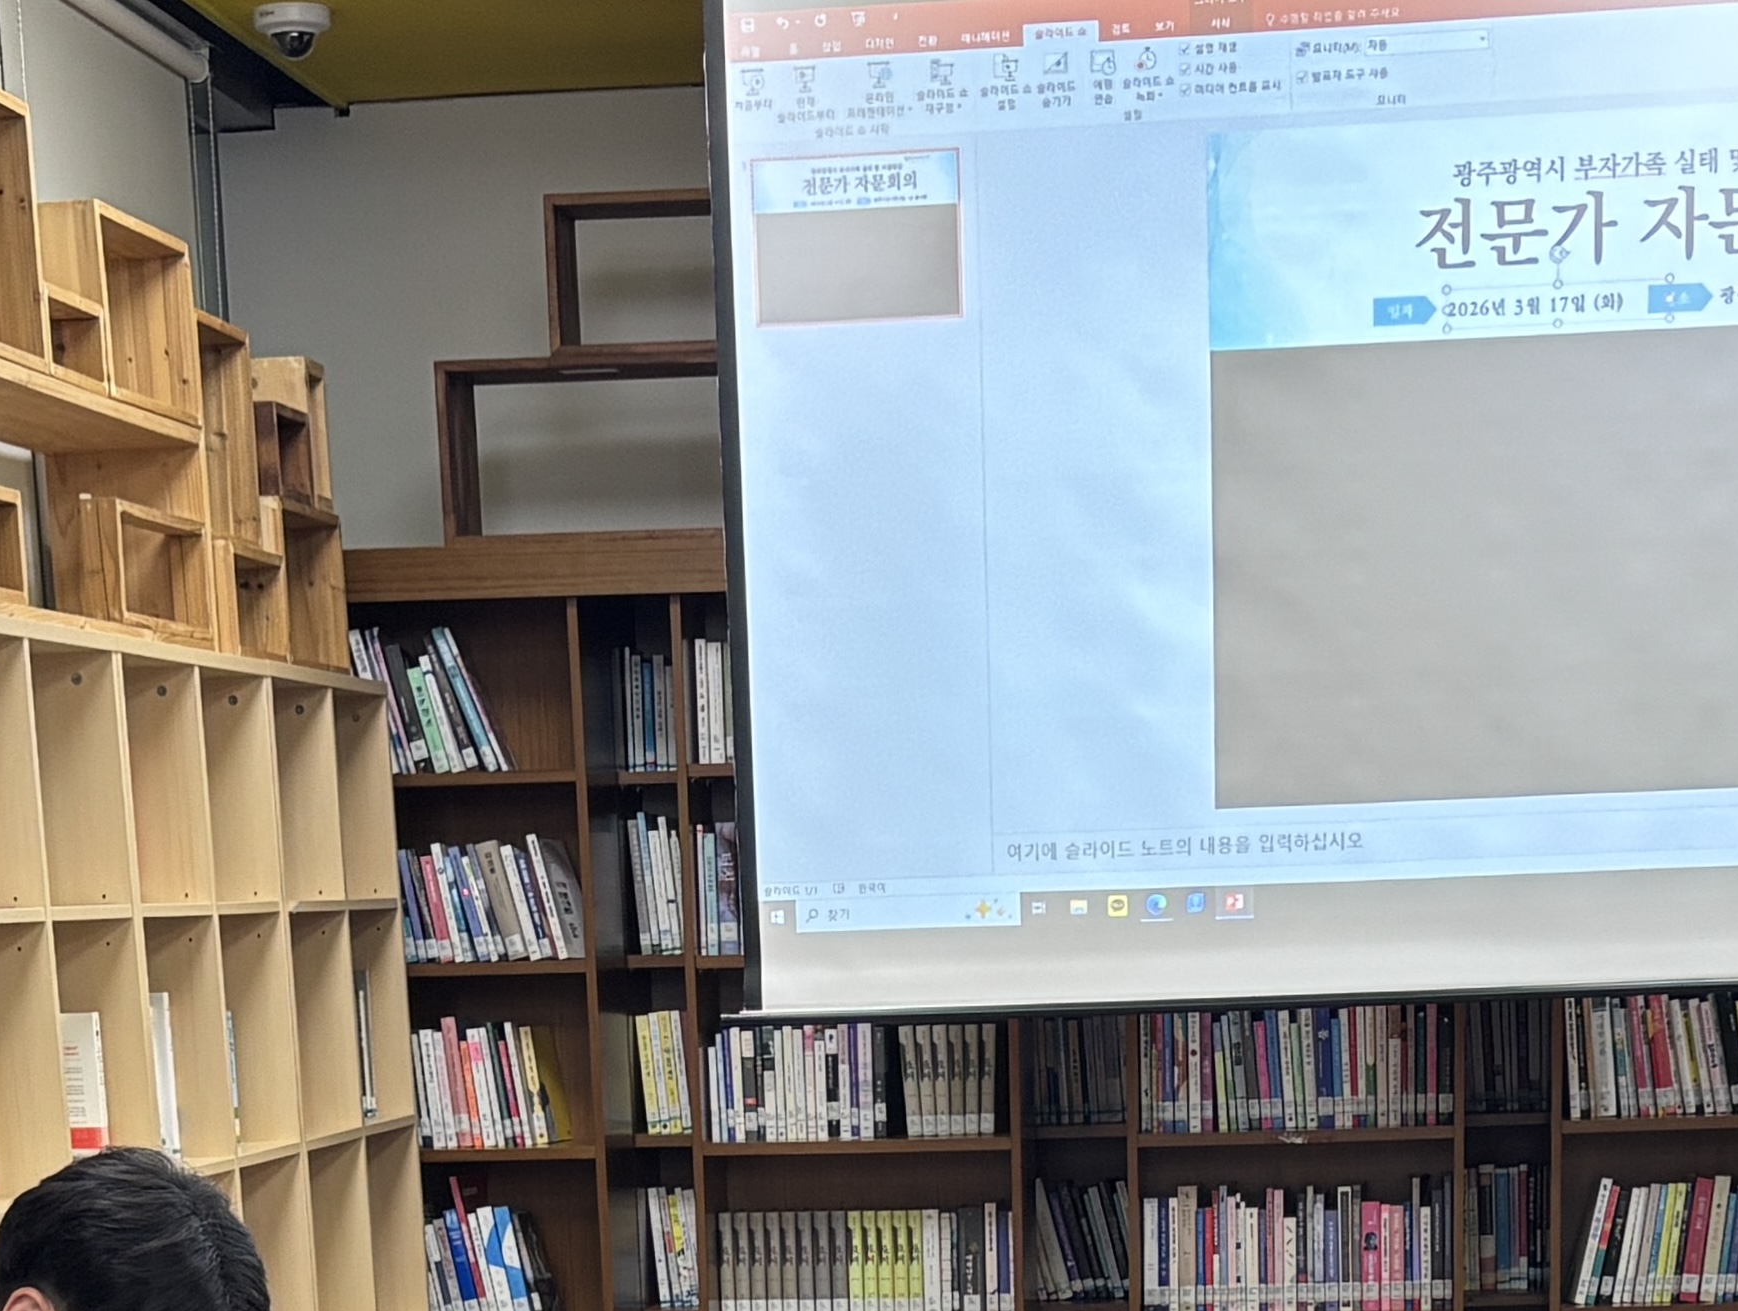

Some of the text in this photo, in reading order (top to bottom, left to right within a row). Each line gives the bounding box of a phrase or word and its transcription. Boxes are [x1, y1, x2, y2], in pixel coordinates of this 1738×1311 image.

[802, 170, 918, 196] 전문가 자문회의
[1452, 156, 1565, 187] 광주광역시
[1574, 148, 1666, 181] 부자가족
[1675, 147, 1718, 175] 실태
[1415, 190, 1619, 270] 전문가
[1446, 297, 1506, 317] 2026년
[1514, 296, 1541, 316] 3월
[1550, 294, 1586, 313] 17일
[1593, 292, 1625, 313] (화)
[1006, 827, 1365, 862] 여기에 슬라이드 노트의 내용을 입력하십시오
